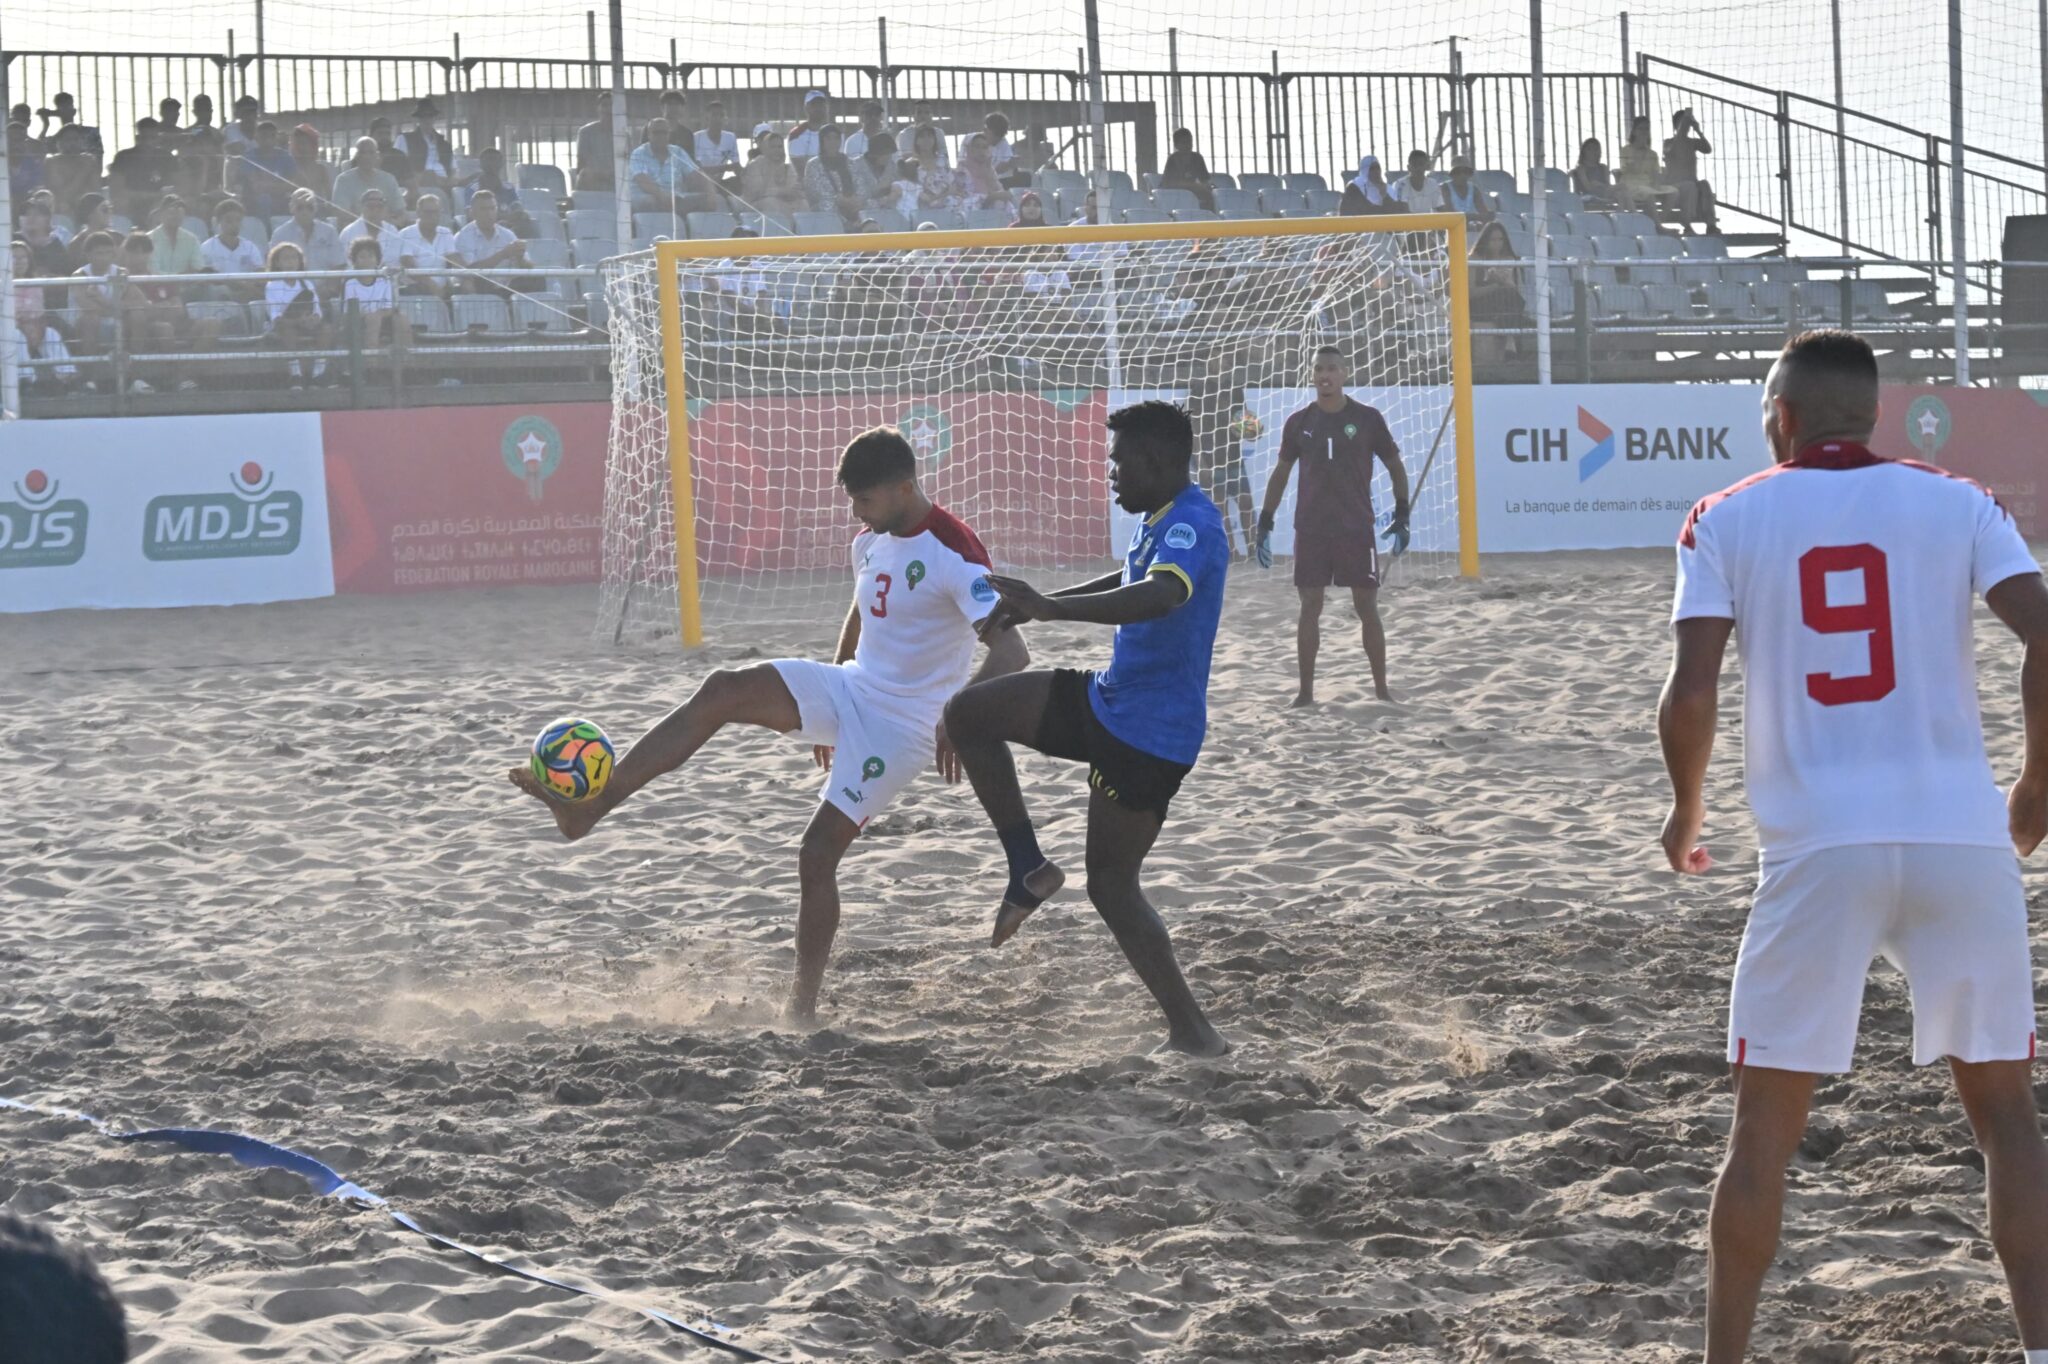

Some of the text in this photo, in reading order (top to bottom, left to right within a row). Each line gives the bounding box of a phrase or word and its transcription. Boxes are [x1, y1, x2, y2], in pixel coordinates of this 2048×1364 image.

[1328, 437, 1333, 459] 1
[1505, 427, 1731, 462] CIH BANK
[155, 503, 290, 543] MDJS
[1506, 500, 1521, 513] La
[1524, 500, 1571, 515] banque
[1574, 499, 1589, 512] de
[1592, 499, 1636, 512] demain
[1641, 498, 1662, 511] dès
[474, 563, 521, 581] ROYALE
[523, 559, 597, 578] MAROCAINE
[870, 573, 892, 618] 3
[1798, 543, 1896, 707] 9
